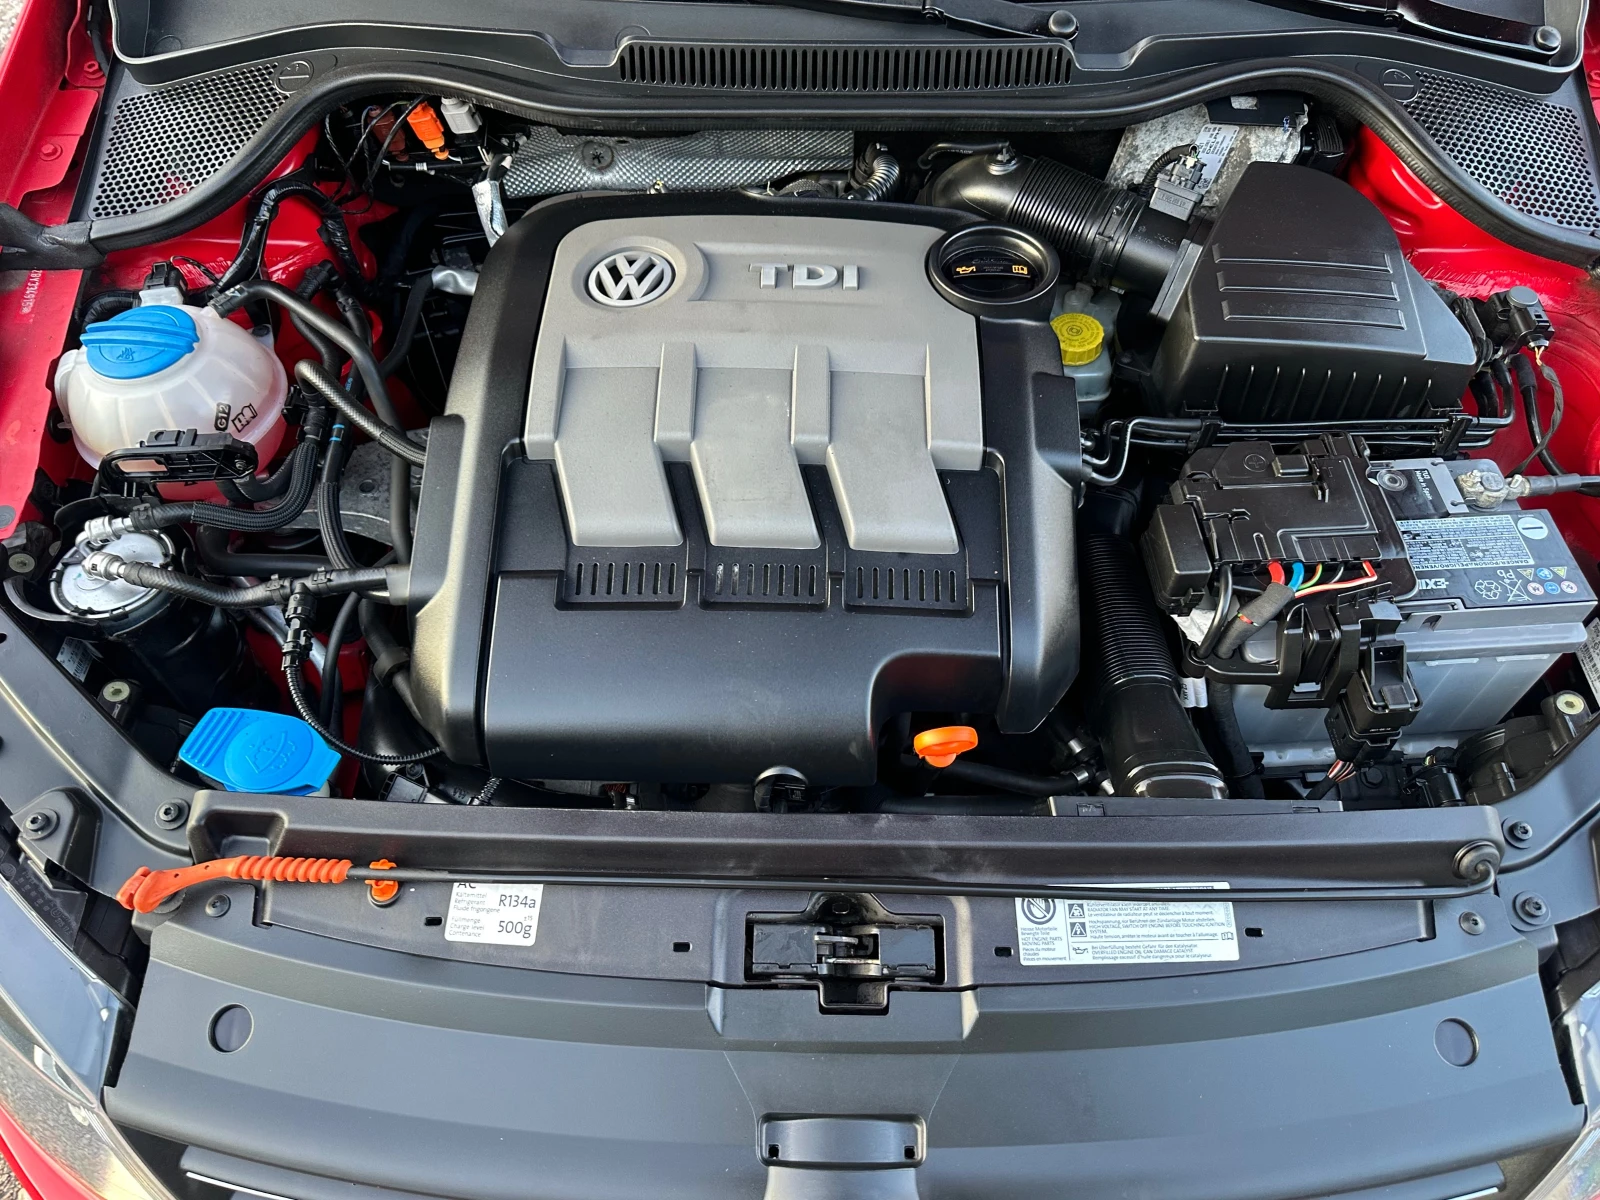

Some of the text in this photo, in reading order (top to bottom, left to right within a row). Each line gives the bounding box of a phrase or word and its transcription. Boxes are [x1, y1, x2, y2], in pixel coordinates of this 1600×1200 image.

[750, 262, 860, 291] TDI
[217, 404, 229, 429] G12
[1496, 569, 1515, 579] Pb
[498, 894, 536, 909] R134a
[497, 920, 533, 939] 500g
